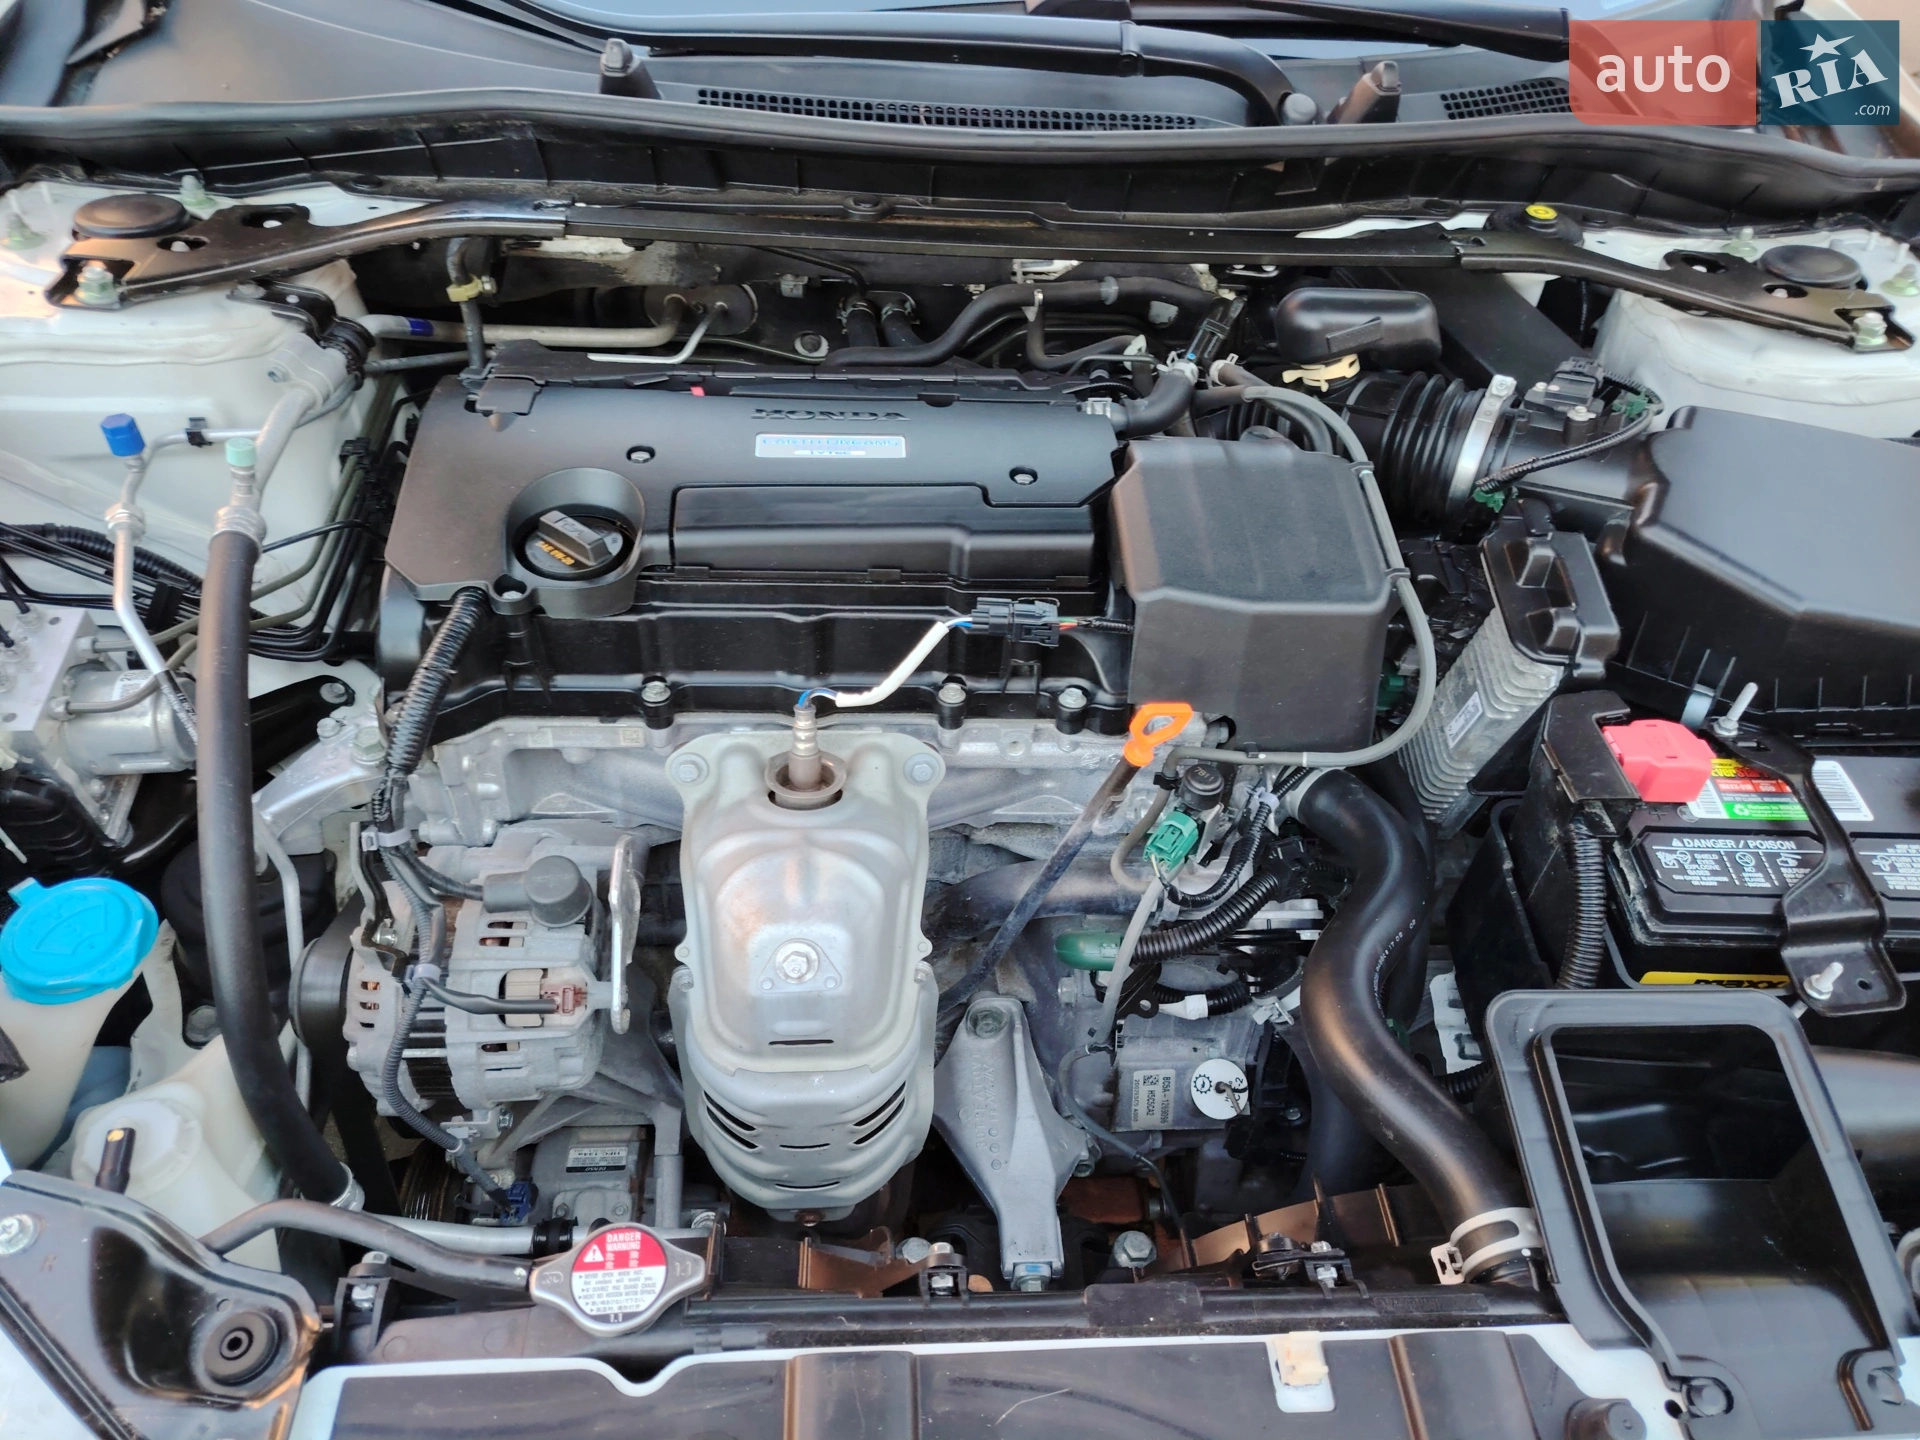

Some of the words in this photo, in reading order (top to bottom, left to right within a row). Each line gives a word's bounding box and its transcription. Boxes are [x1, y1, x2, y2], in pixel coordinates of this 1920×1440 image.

[751, 408, 911, 421] HONDA
[1683, 838, 1736, 849] DANGER
[1748, 840, 1796, 851] POISON
[606, 1231, 642, 1242] DANGER
[605, 1241, 641, 1252] WARNUNG
[674, 1261, 692, 1277] 1.1
[609, 1313, 623, 1323] 1.1
